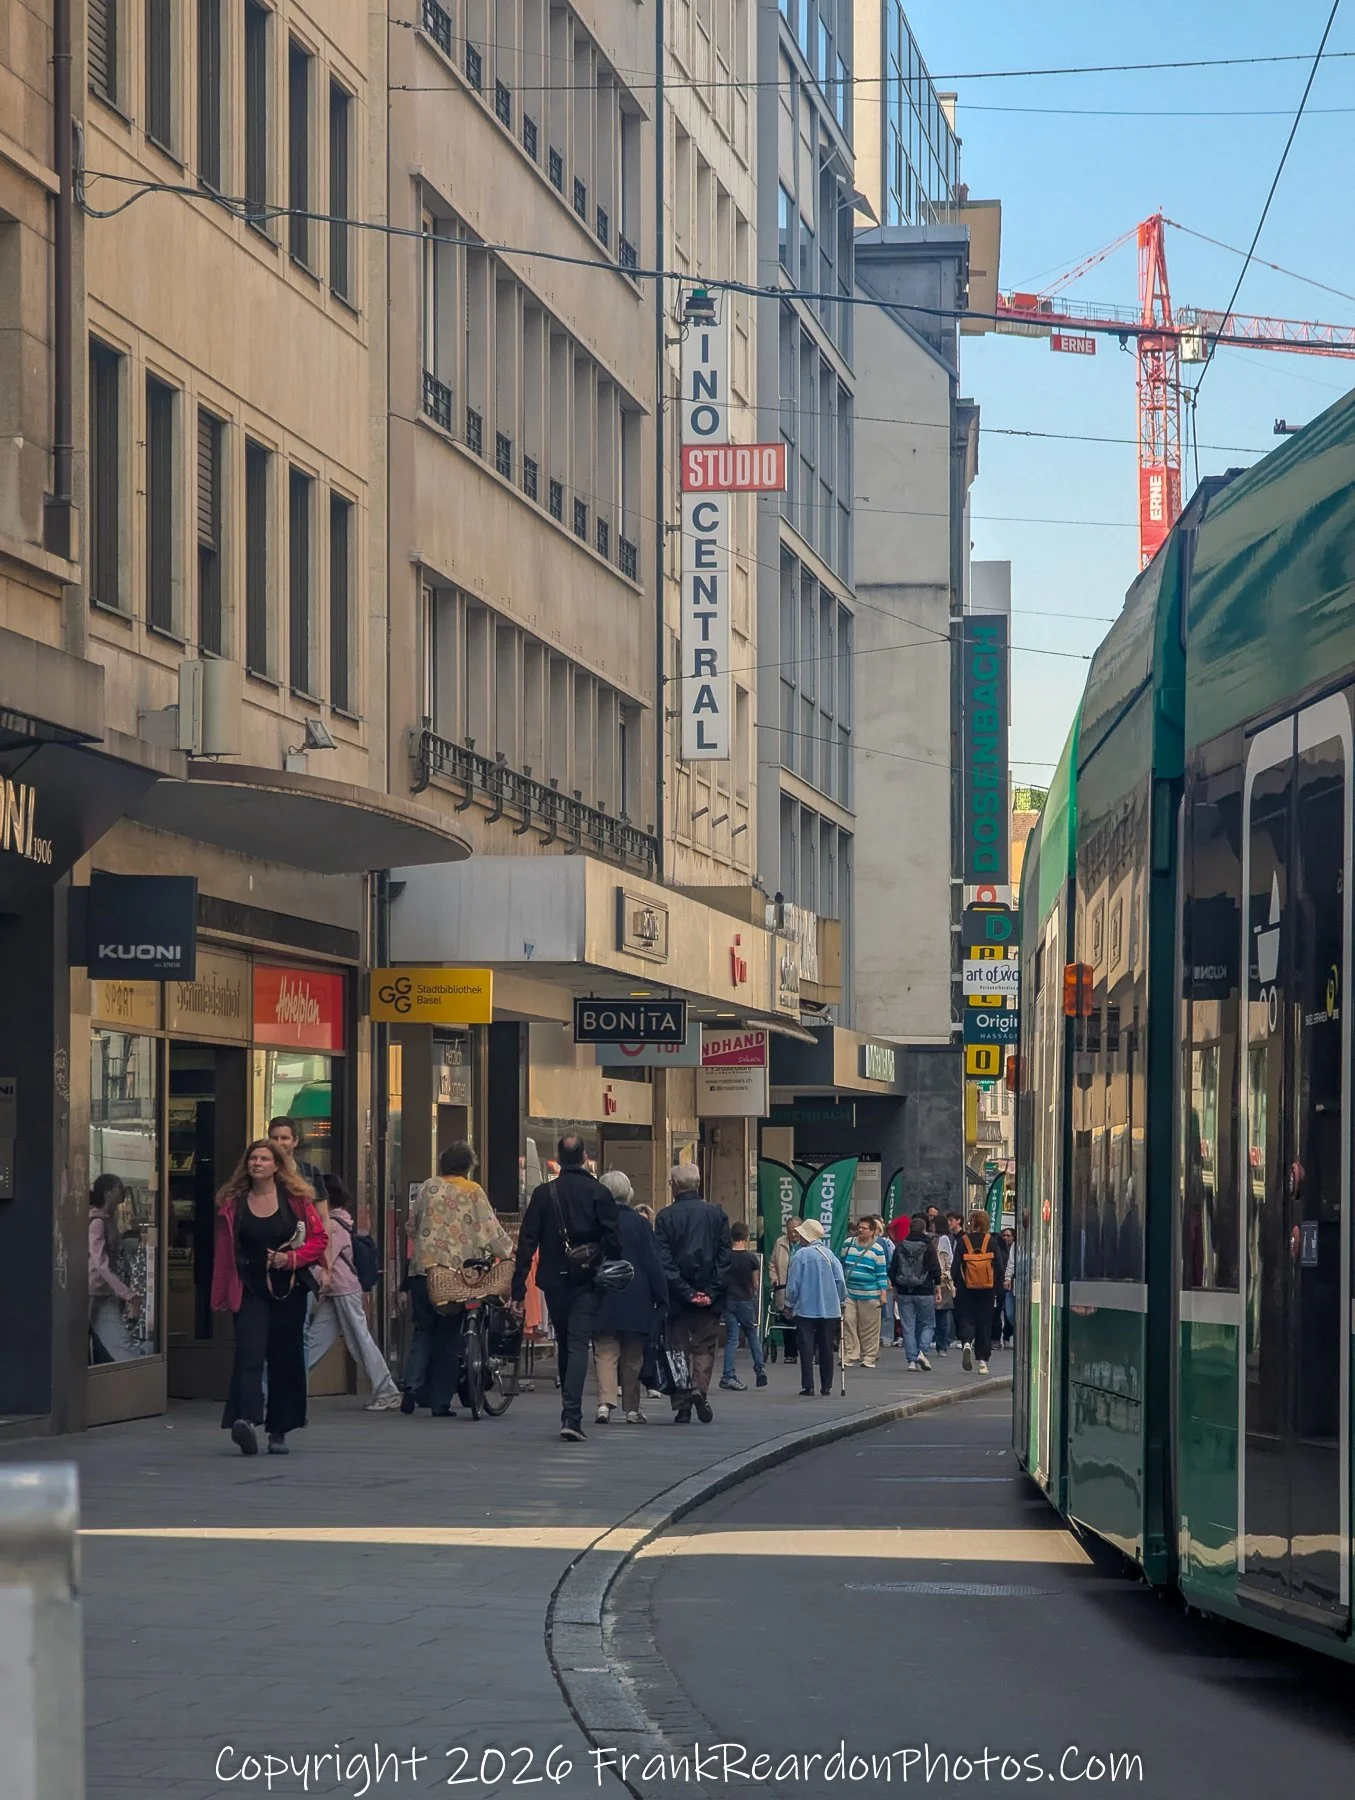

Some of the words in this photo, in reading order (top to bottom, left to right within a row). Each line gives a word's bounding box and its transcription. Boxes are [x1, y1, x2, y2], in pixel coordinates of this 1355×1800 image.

[1061, 336, 1093, 353] ERNE
[688, 447, 778, 487] STUDIO
[1149, 475, 1162, 521] ERNE
[691, 501, 720, 750] CENTRAL
[972, 626, 1000, 873] DOSENBACH
[33, 837, 52, 865] 1906
[98, 944, 182, 960] KUONI
[966, 967, 983, 982] art
[985, 965, 998, 983] of
[416, 995, 442, 1005] Basel
[417, 984, 483, 994] Stadtbibliothek
